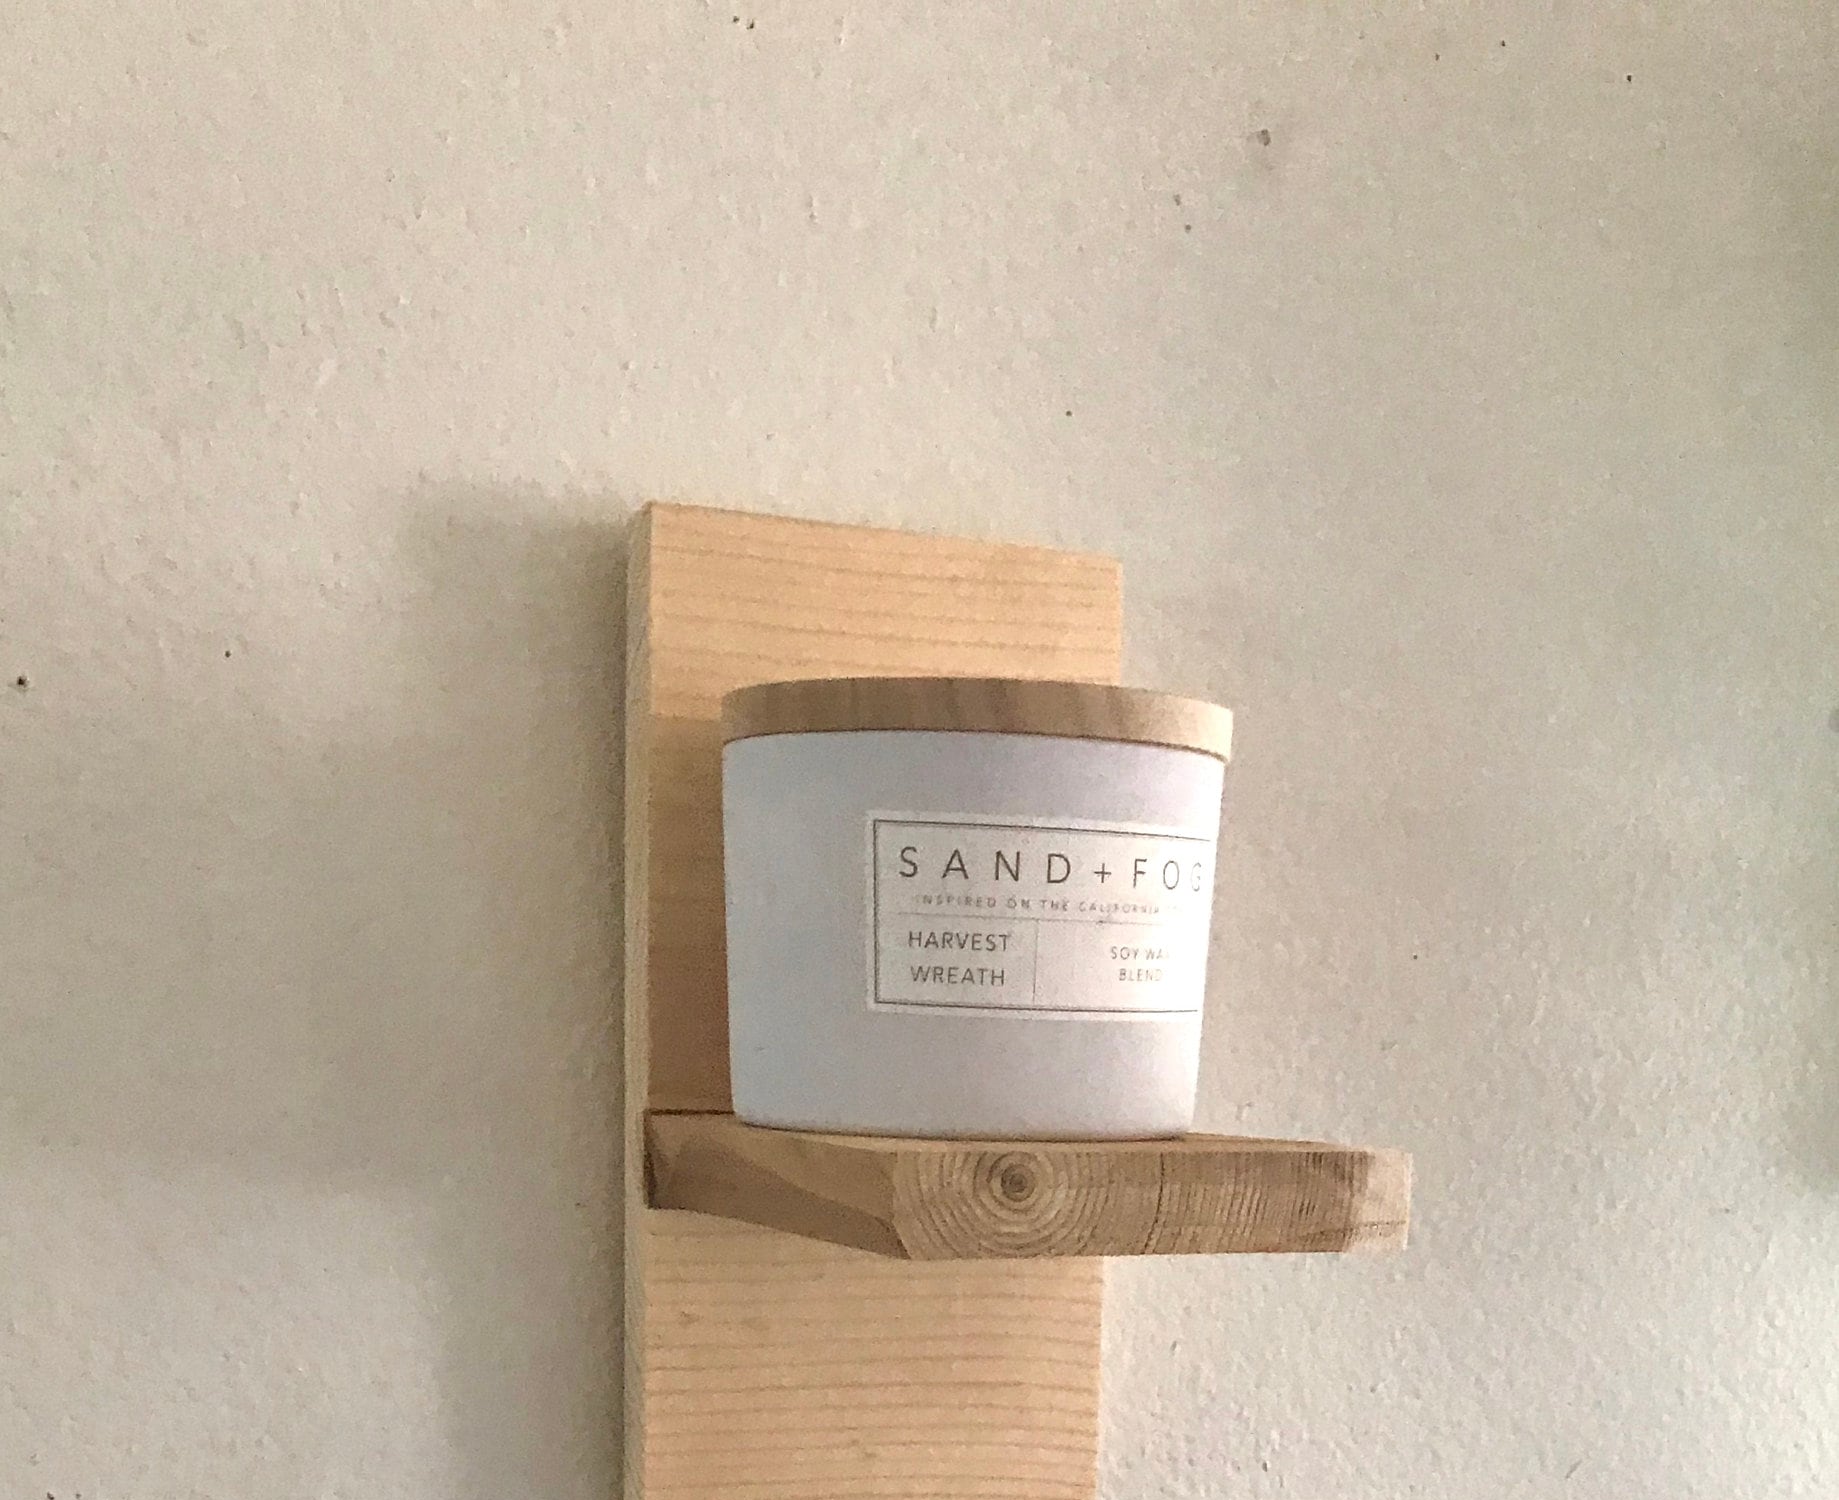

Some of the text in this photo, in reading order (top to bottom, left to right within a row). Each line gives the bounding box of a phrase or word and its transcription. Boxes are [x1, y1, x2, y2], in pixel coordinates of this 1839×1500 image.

[913, 894, 997, 908] INSPIRED
[1007, 896, 1031, 909] ON
[1040, 899, 1069, 912] THE
[908, 930, 1010, 951] HARVEST
[1110, 945, 1139, 960] SOY
[910, 965, 1005, 986] WREATH
